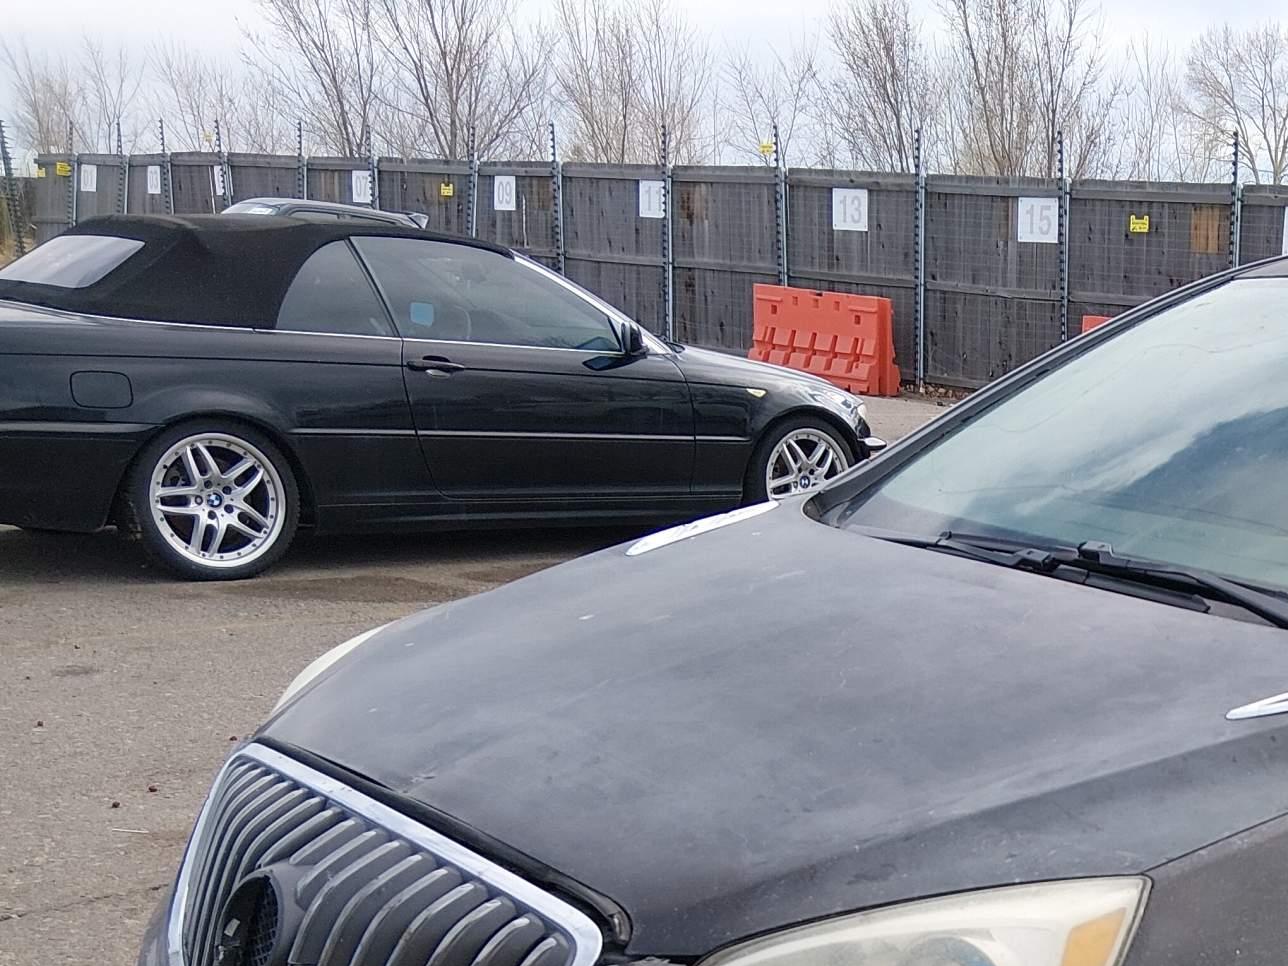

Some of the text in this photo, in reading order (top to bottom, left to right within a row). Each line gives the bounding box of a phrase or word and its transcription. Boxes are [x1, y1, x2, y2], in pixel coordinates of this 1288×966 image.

[497, 181, 512, 204] 09
[644, 185, 663, 212] 11
[840, 195, 862, 224] 13
[1026, 204, 1052, 236] 15
